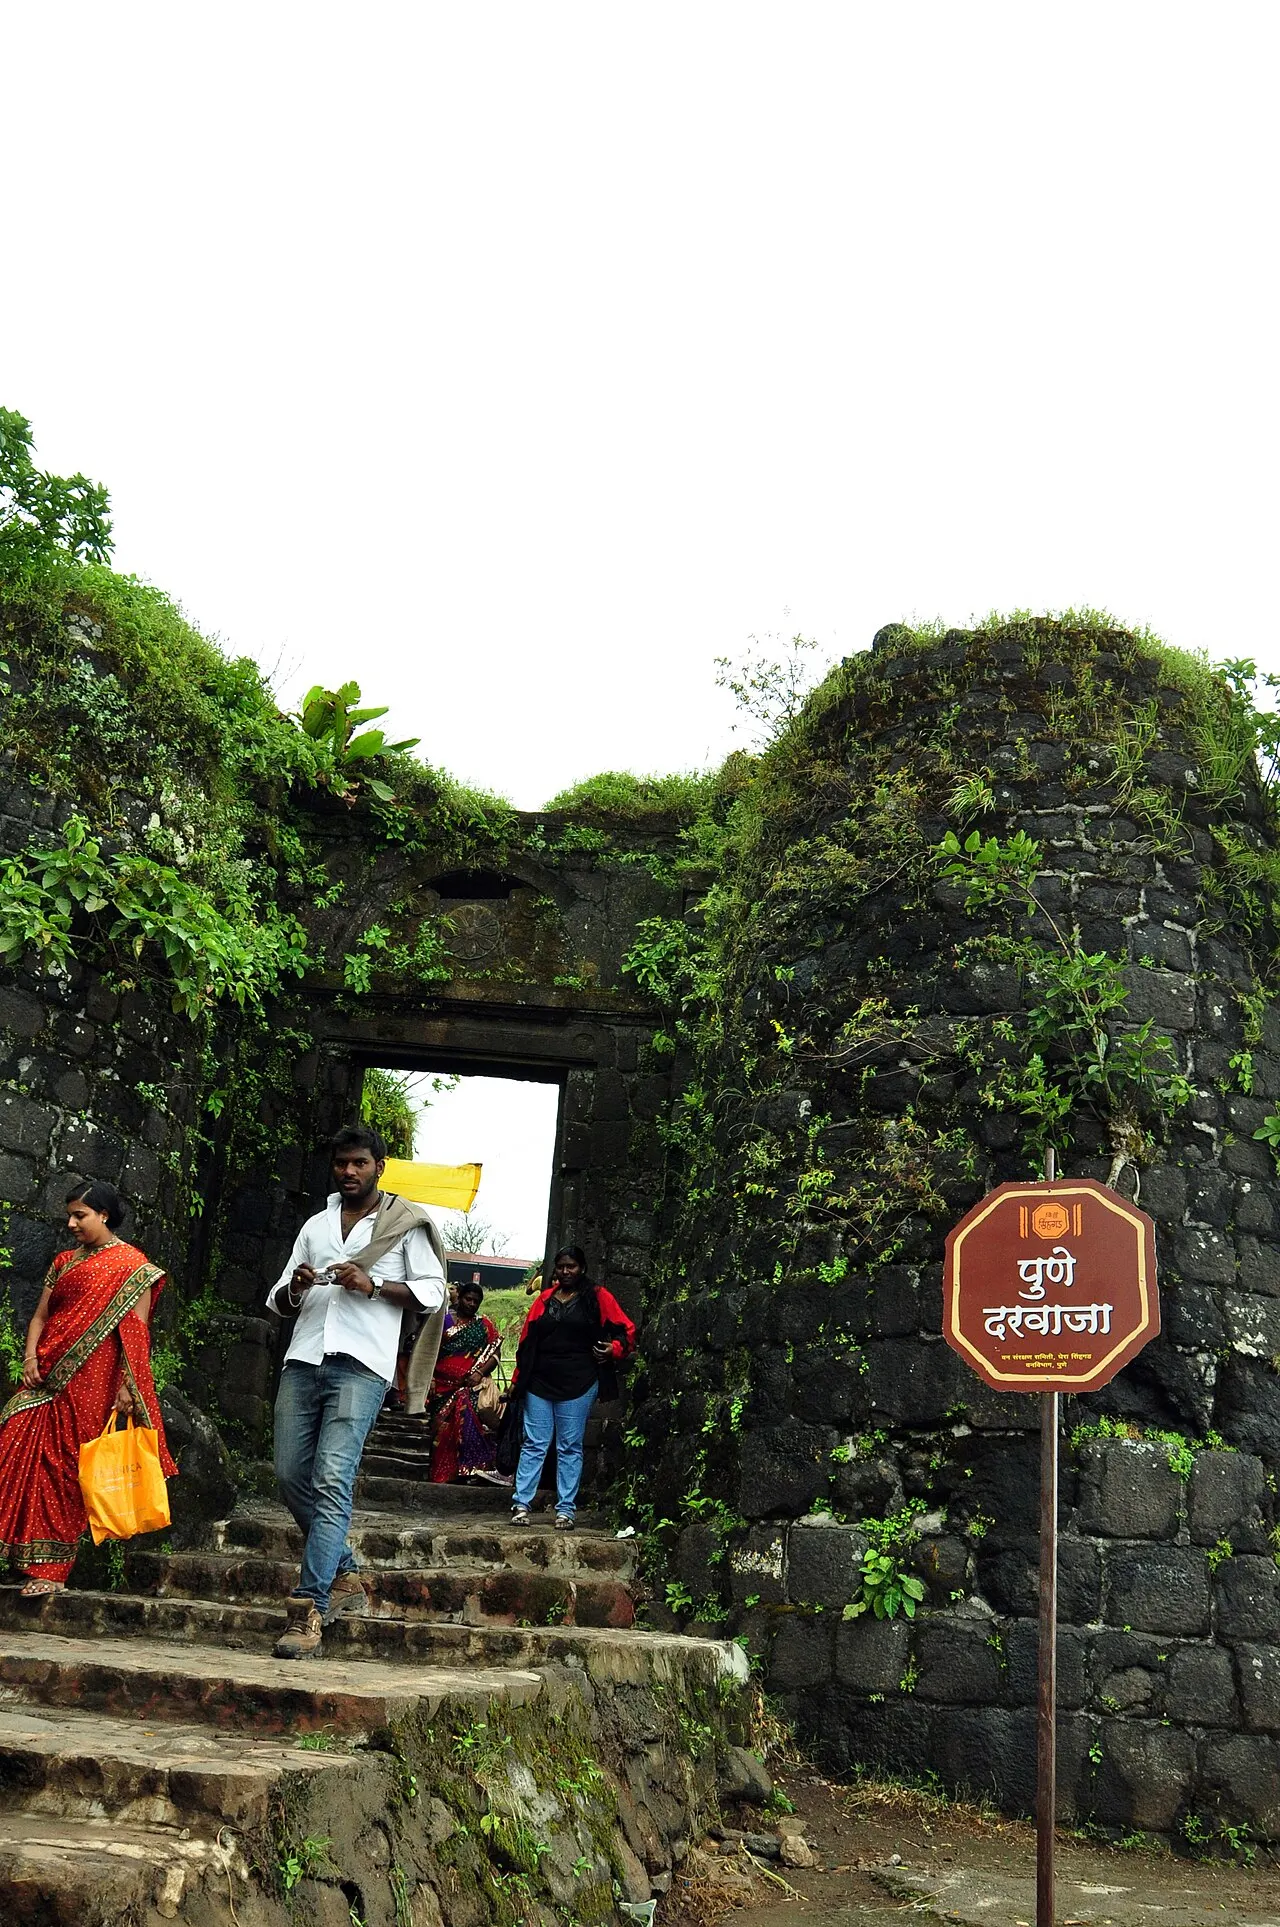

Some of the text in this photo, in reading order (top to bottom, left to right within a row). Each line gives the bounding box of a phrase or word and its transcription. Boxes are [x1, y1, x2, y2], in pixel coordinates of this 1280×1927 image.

[1017, 1246, 1077, 1300] पुणे
[982, 1303, 1114, 1341] दरवाजा
[1056, 1361, 1067, 1369] पुणे
